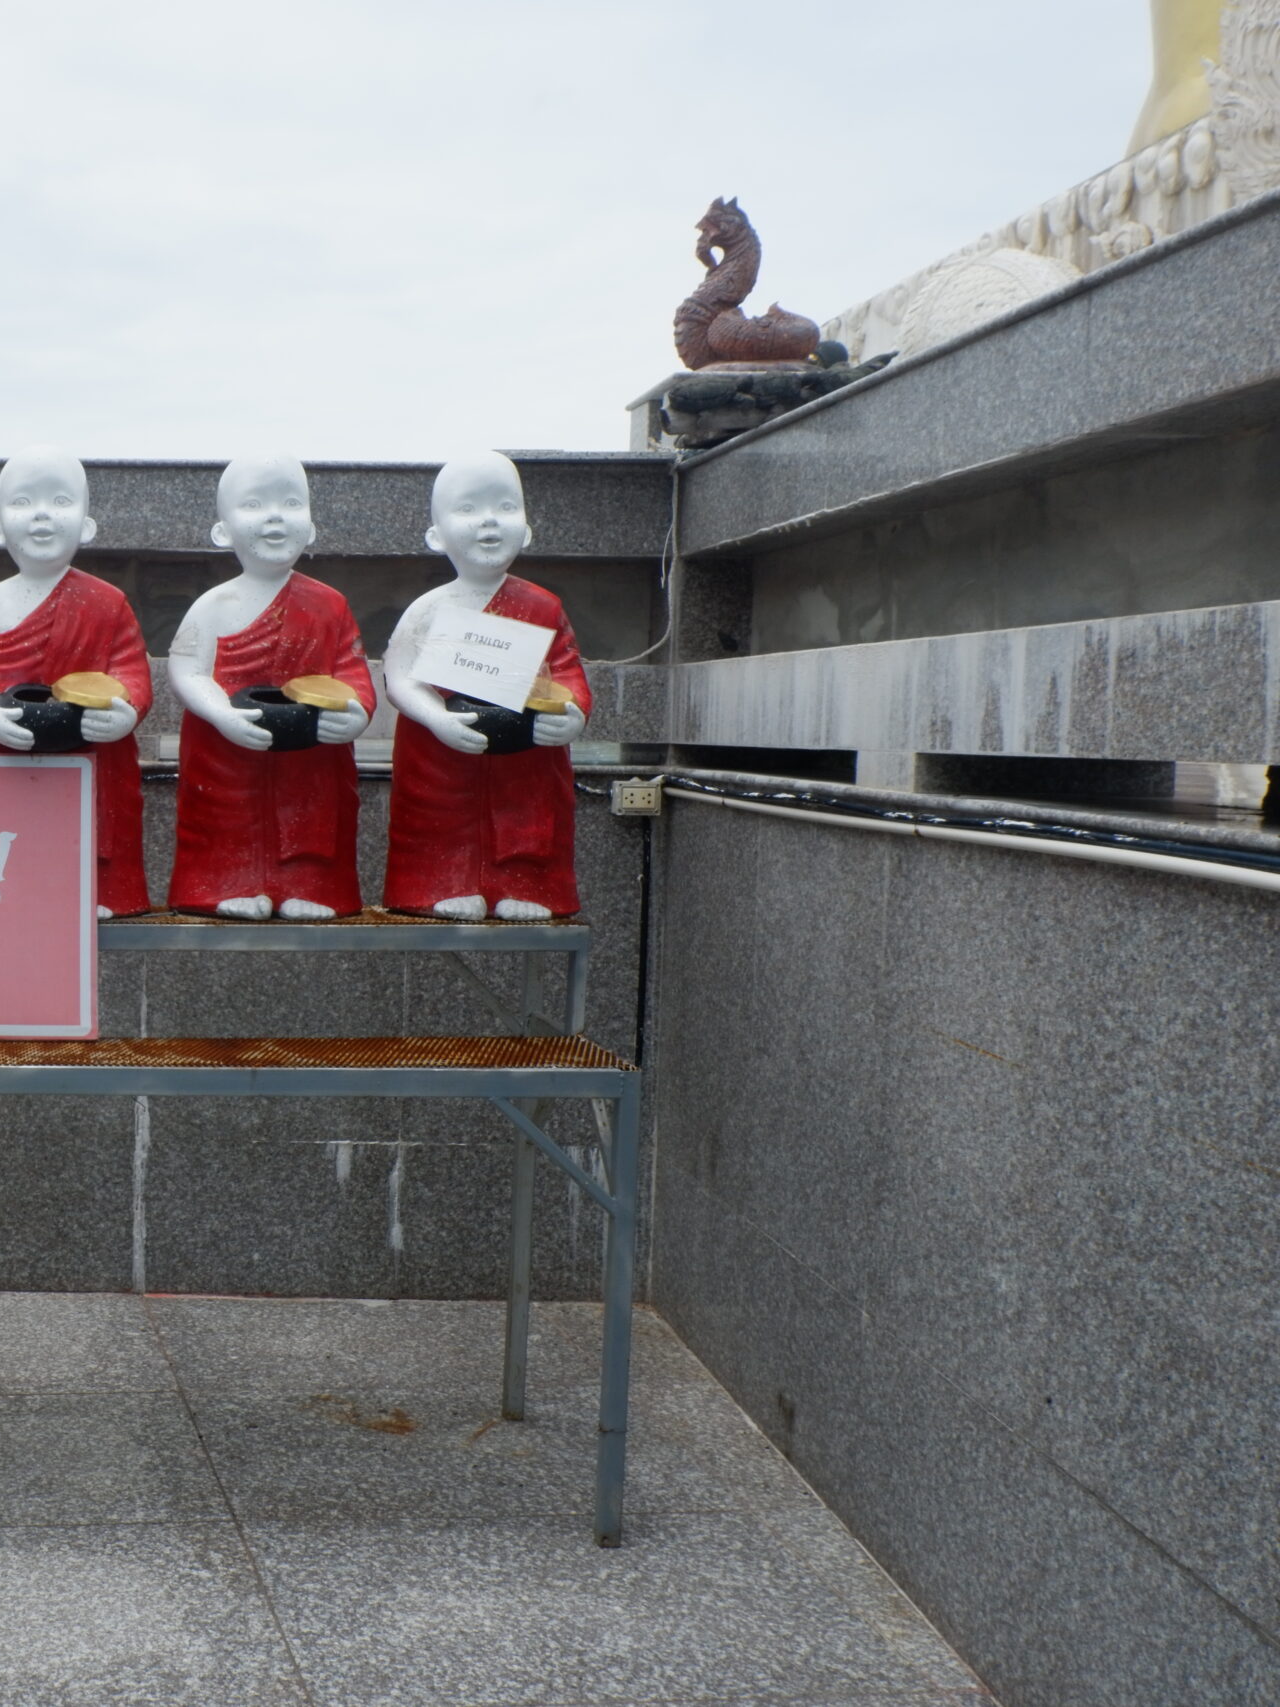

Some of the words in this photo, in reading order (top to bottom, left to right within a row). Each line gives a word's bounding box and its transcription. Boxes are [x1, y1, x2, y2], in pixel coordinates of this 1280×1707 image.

[463, 630, 513, 651] สามเณร
[452, 651, 501, 677] โชคลาภ
